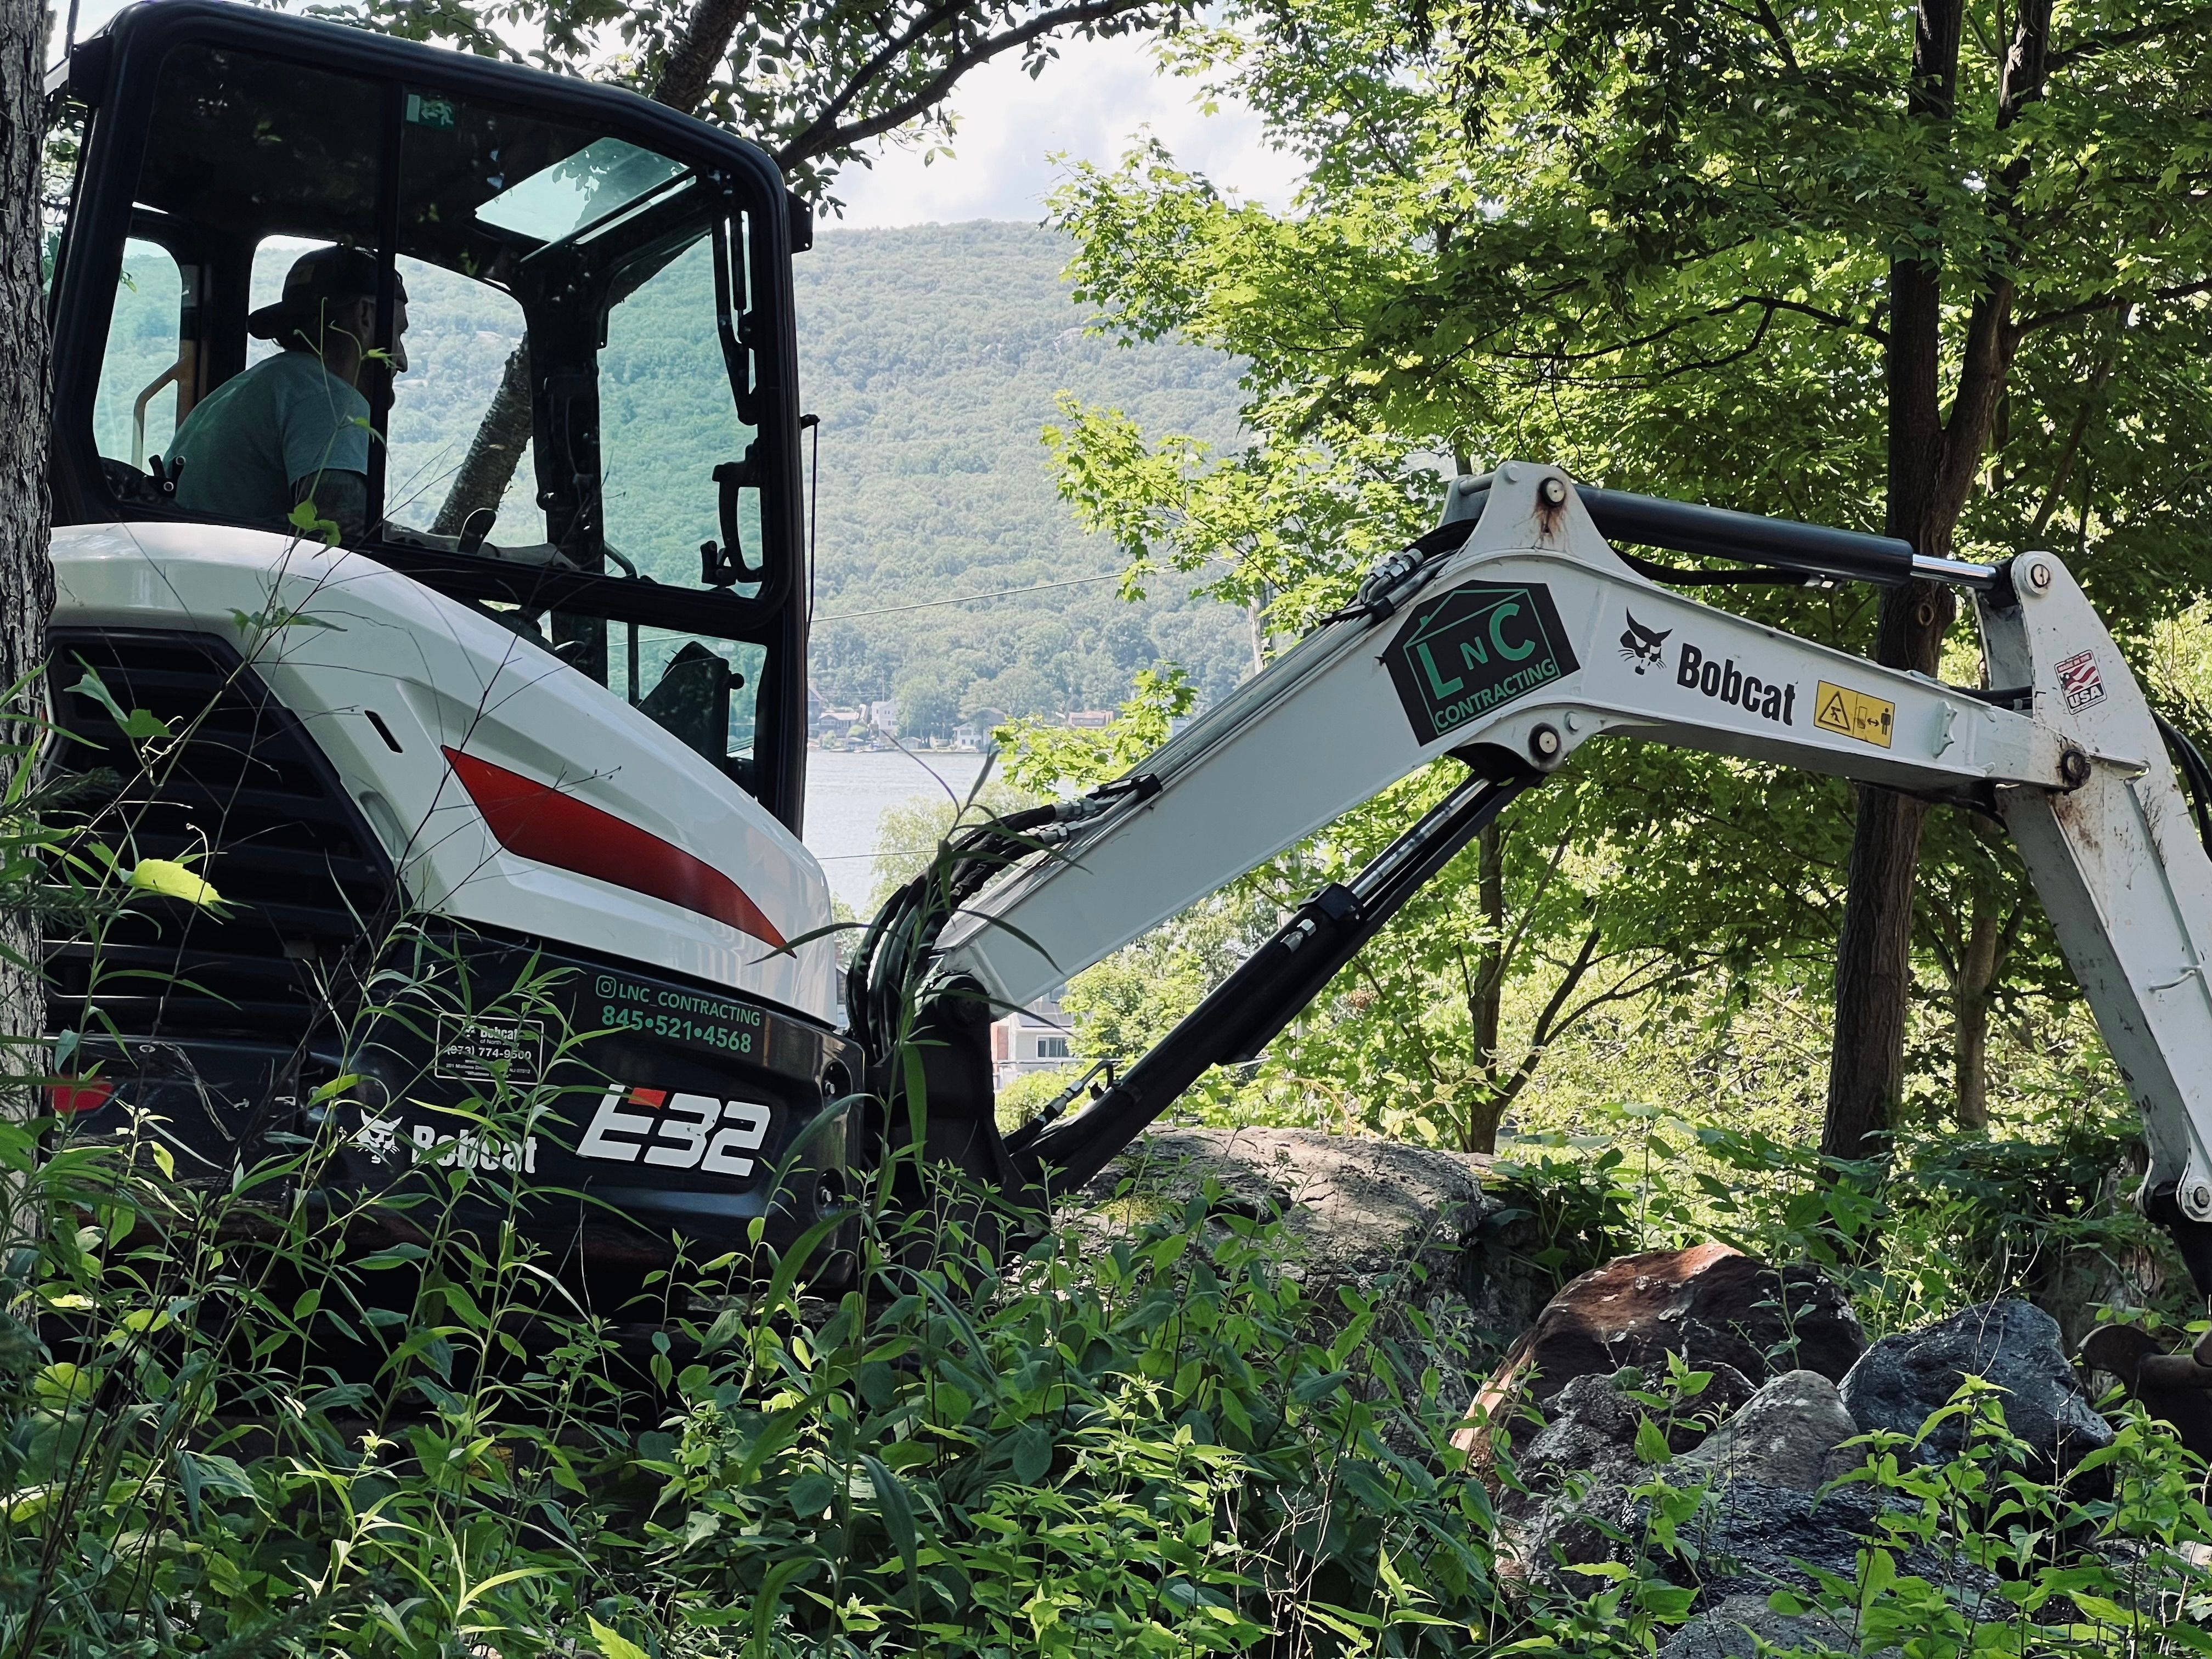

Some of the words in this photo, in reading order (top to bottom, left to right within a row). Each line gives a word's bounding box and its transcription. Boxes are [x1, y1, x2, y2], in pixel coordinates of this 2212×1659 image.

[1435, 658, 1556, 729] CONTRACTING
[1677, 642, 1796, 726] Bobcat
[2068, 686, 2102, 708] USA
[411, 1125, 537, 1173] Bobcat
[577, 1084, 771, 1177] E32
